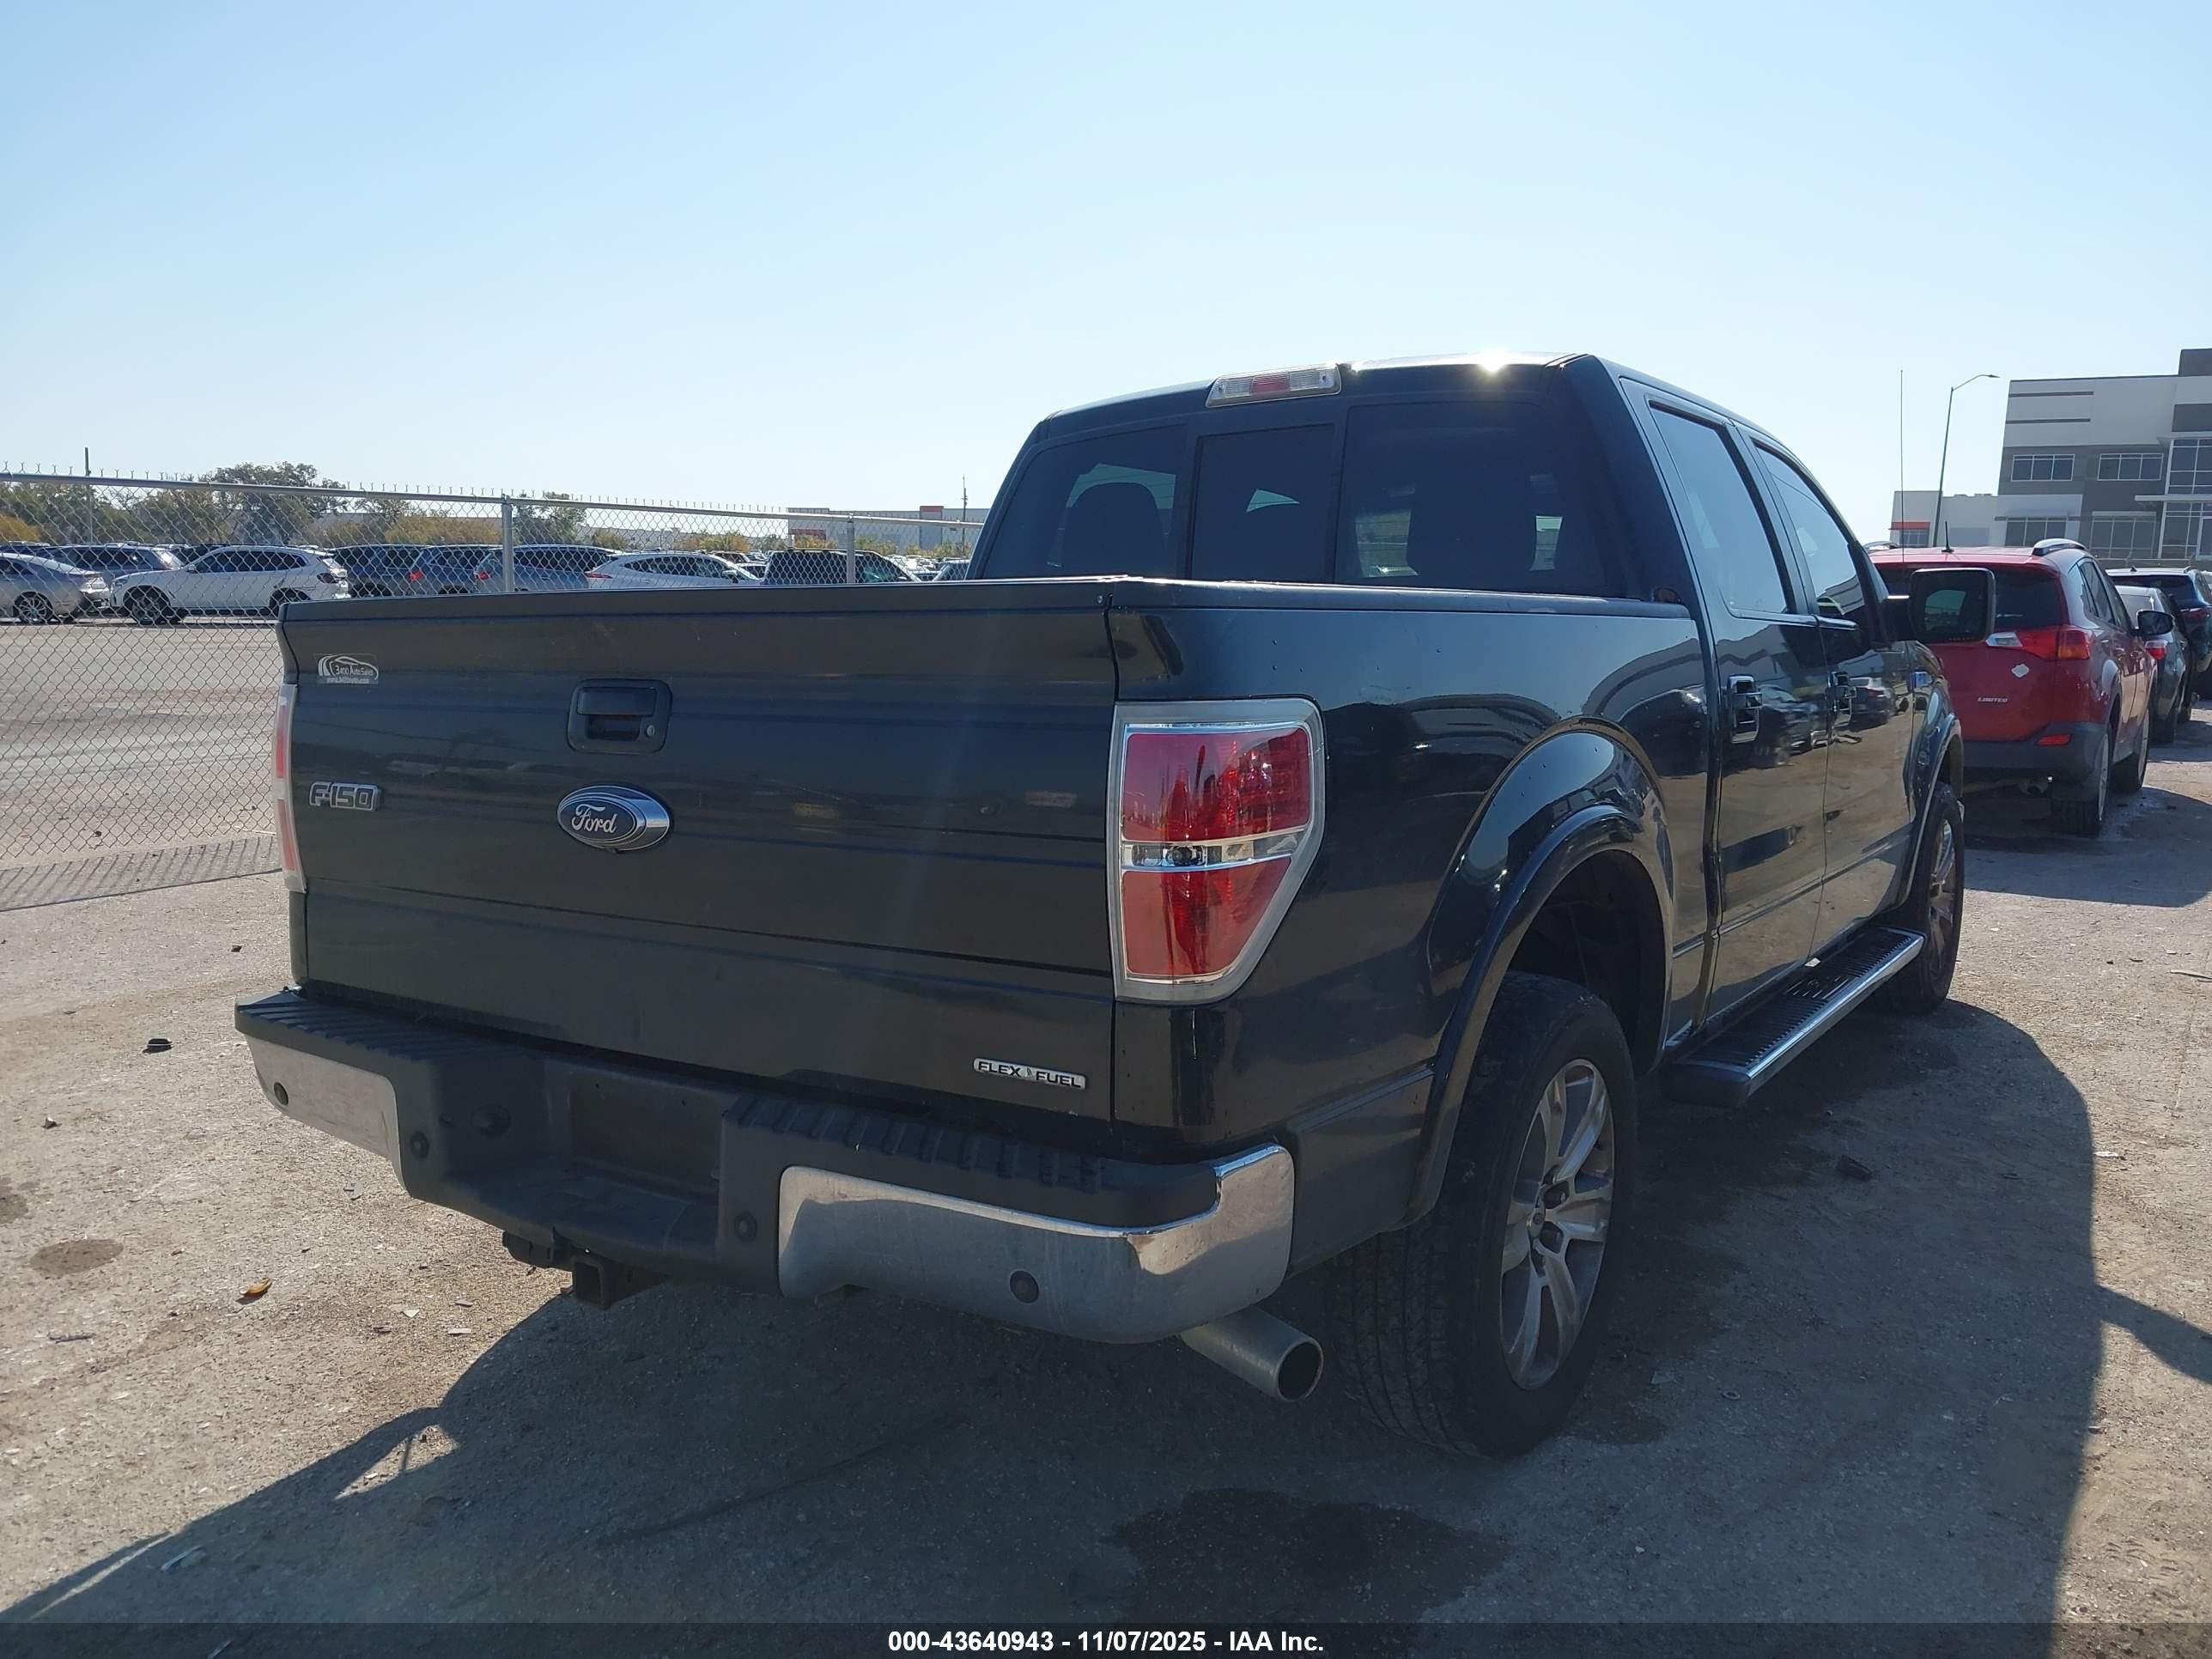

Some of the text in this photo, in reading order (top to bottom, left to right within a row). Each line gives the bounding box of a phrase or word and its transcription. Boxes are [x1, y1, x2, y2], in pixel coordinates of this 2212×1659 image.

[571, 804, 617, 833] Ford
[979, 1061, 1081, 1088] FLEX FUEL
